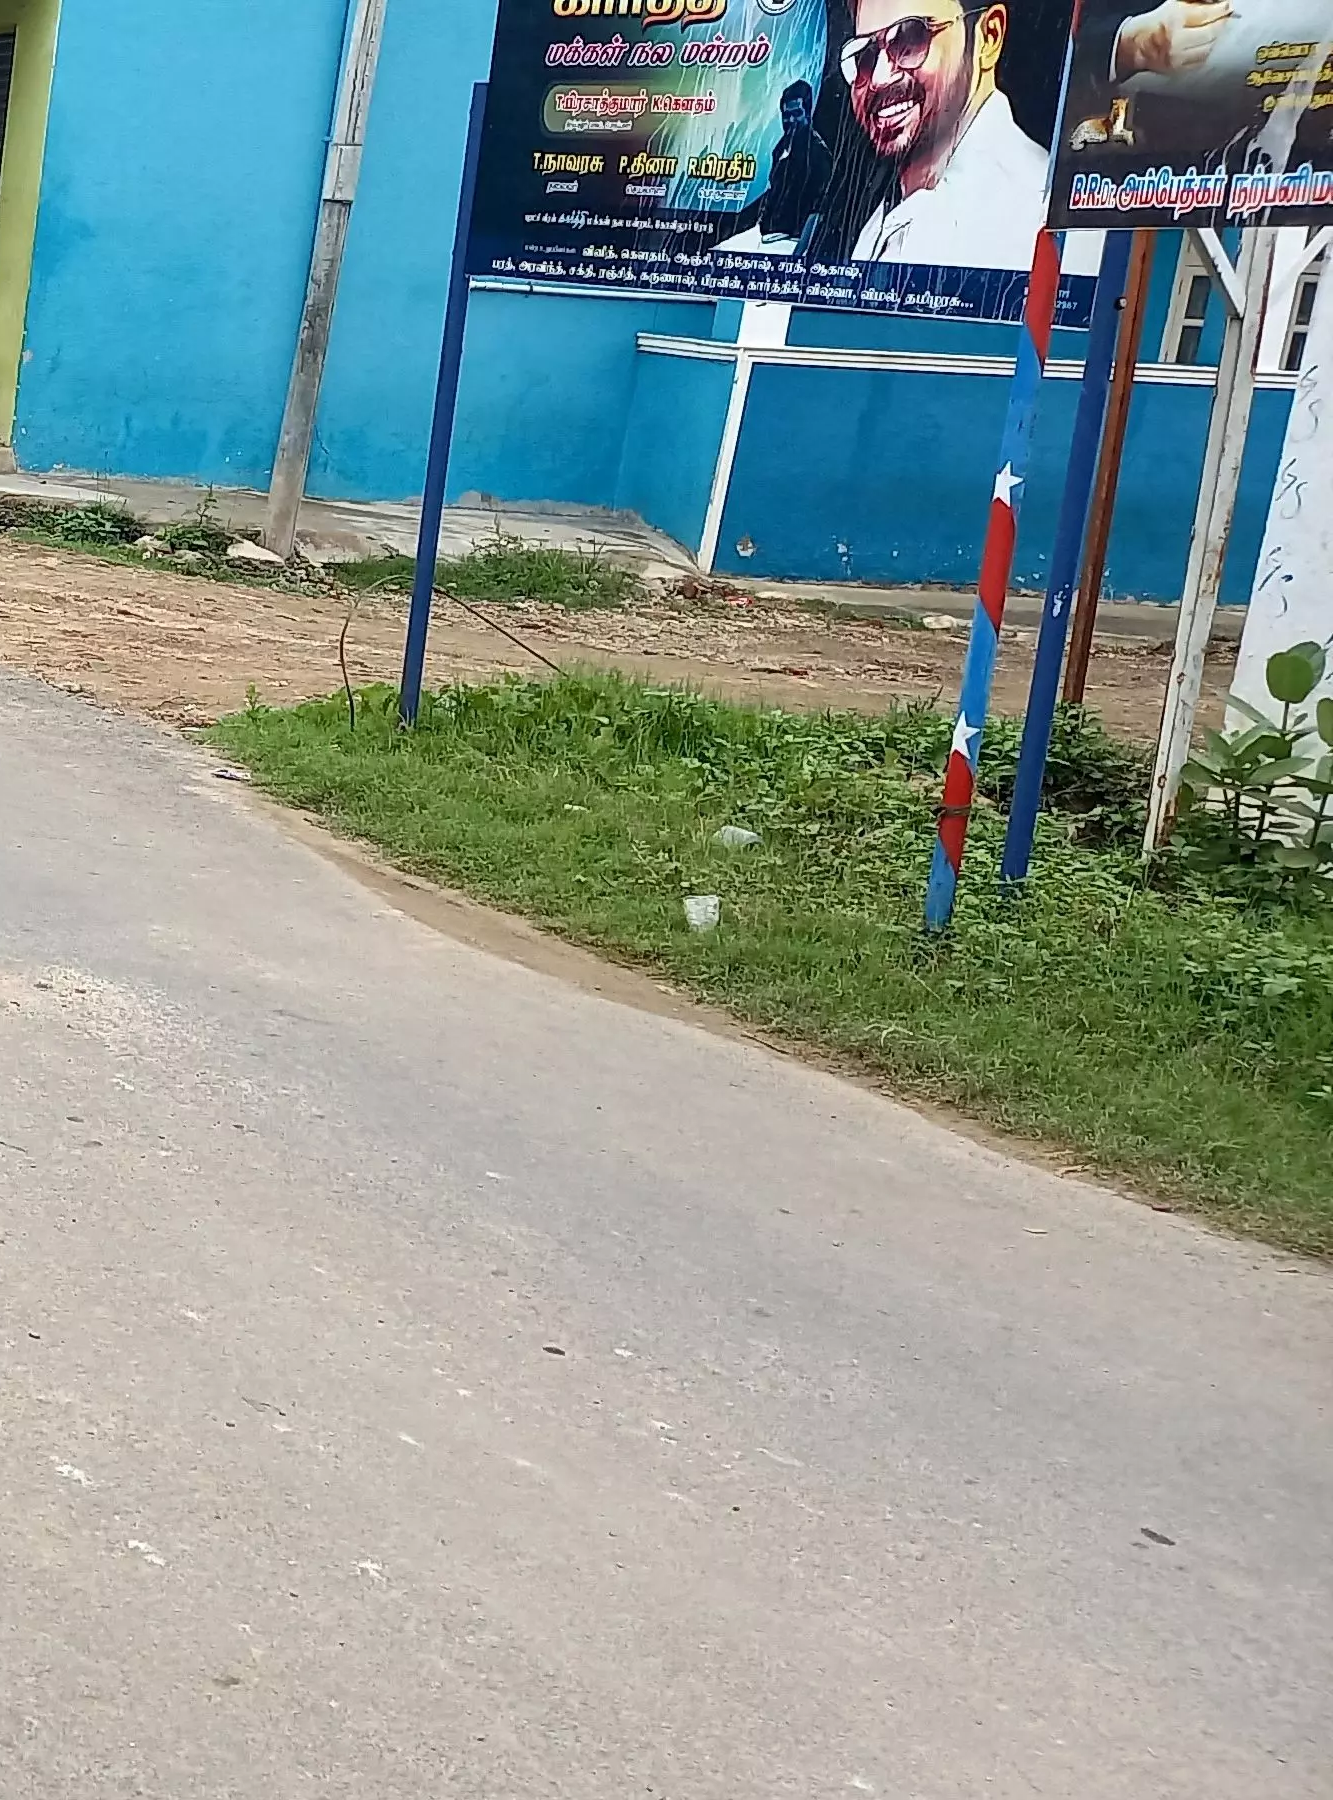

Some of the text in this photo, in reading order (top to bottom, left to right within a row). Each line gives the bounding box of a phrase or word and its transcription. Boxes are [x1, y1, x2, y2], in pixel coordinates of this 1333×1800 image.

[545, 33, 771, 72] மக்கள் நல மன்றம்
[533, 152, 756, 182] T.நாவரசு P.தினா R.பிரதீப்
